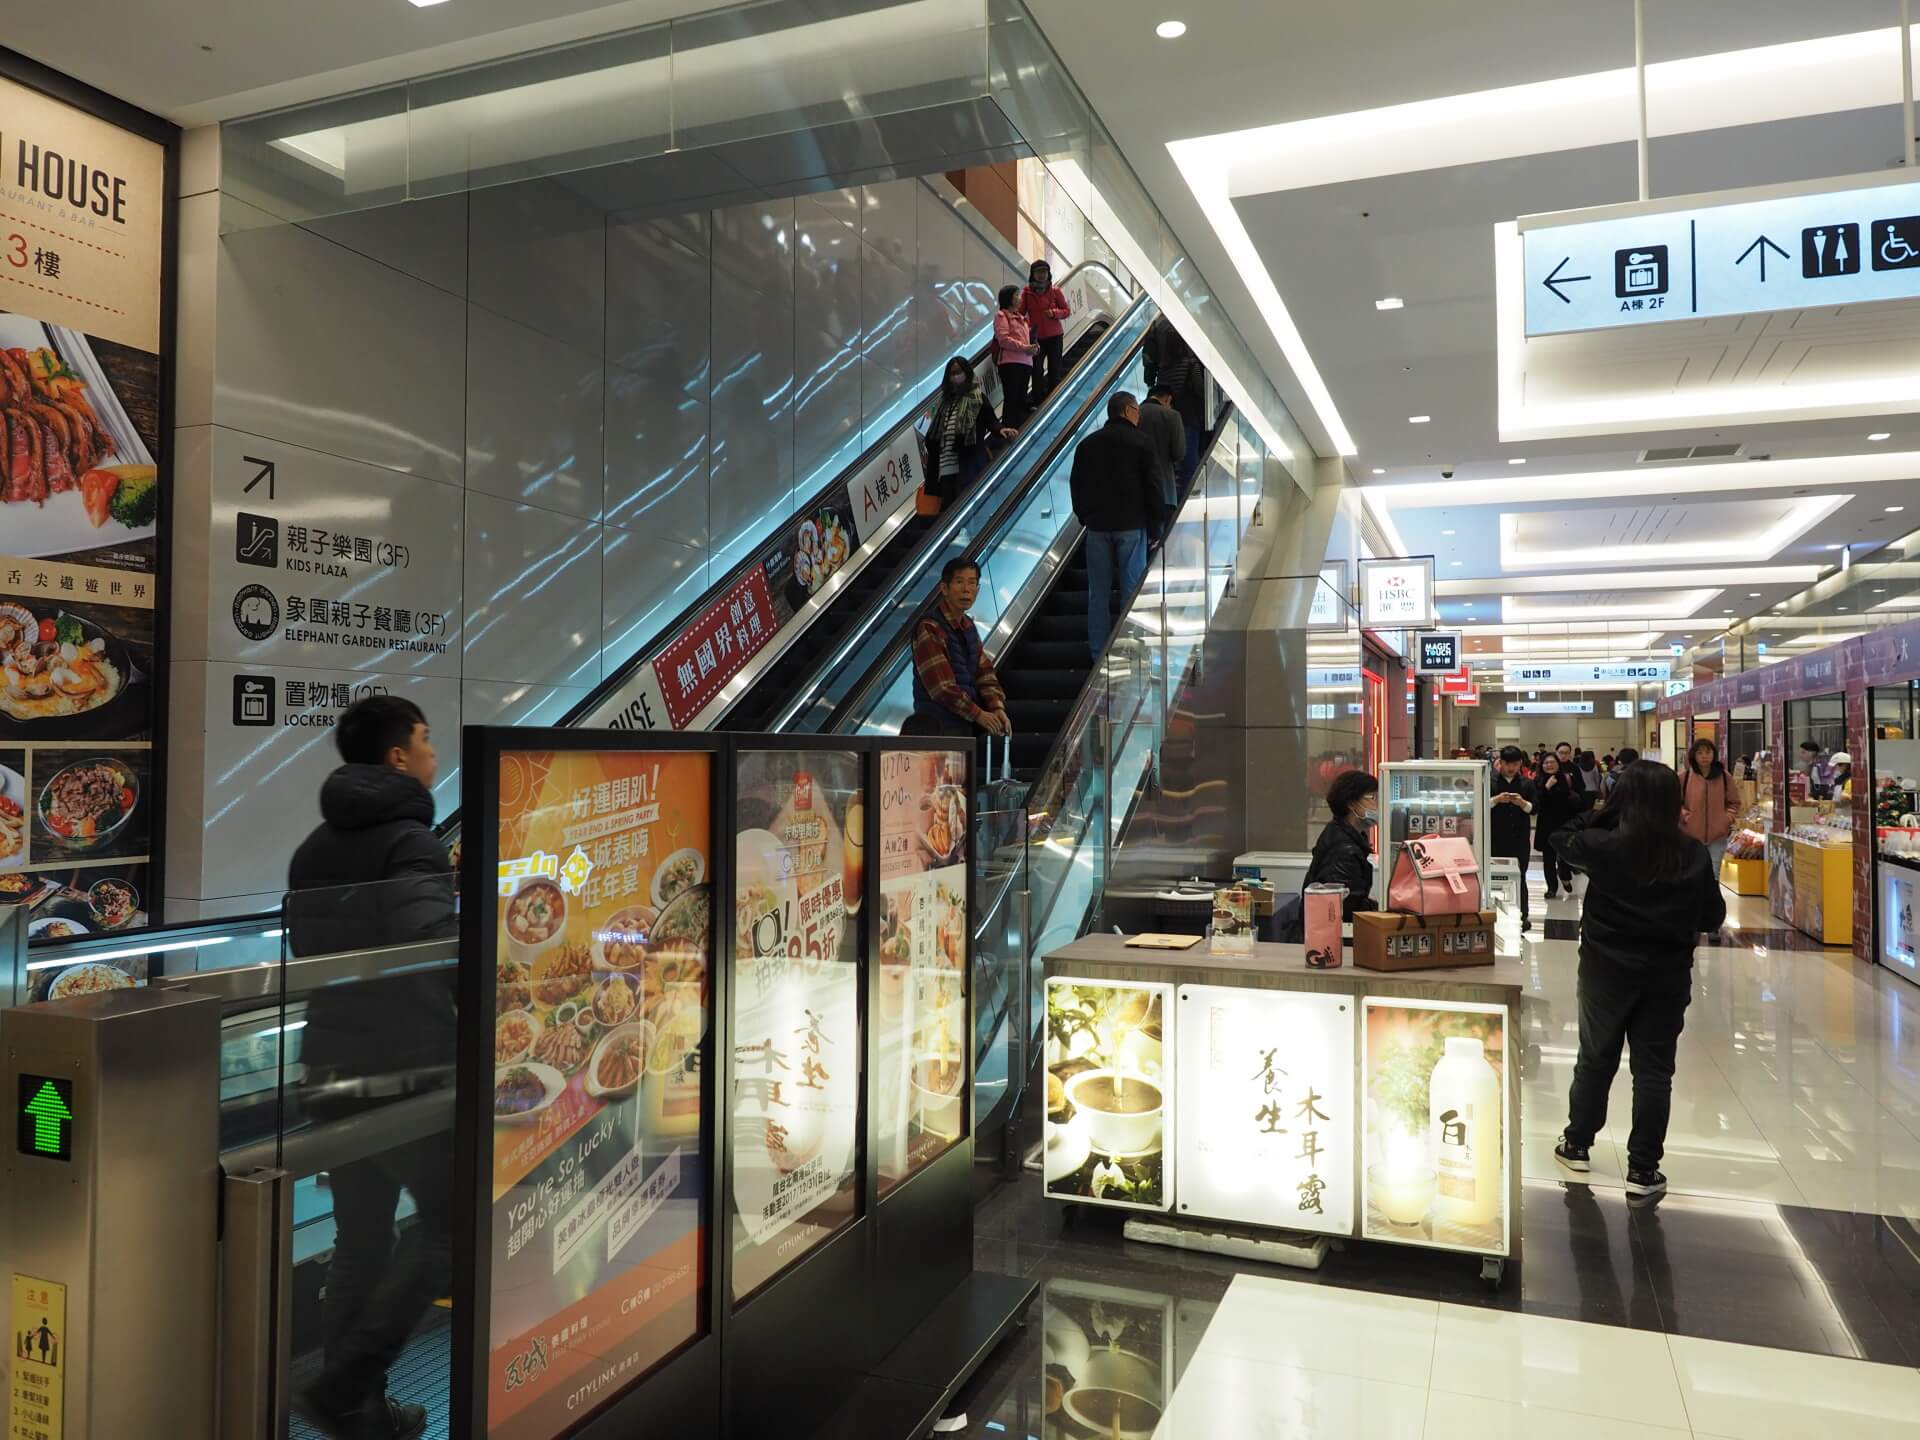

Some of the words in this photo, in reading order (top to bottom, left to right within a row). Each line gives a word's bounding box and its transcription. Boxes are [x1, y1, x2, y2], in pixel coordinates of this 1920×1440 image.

[18, 139, 127, 225] HOUSE
[71, 215, 96, 228] BAR
[7, 233, 62, 280] 3樓
[1620, 299, 1645, 313] A棟
[1649, 296, 1666, 310] 2F
[863, 452, 915, 523] A棟3樓
[287, 525, 410, 569] 親子樂園(3F)
[286, 558, 311, 574] KIDS
[314, 563, 349, 578] PLAZA
[730, 589, 756, 626] 創意
[1378, 588, 1413, 601] HSBC
[286, 596, 447, 637] 象園親子餐廳(3F)
[736, 611, 764, 652] 料理
[285, 628, 340, 646] ELEPHANT
[342, 633, 386, 650] GARDEN
[388, 637, 448, 655] RESTAURANT
[1425, 643, 1451, 651] MAGIC
[1425, 649, 1451, 657] TOUCH
[677, 622, 733, 699] 無國界
[284, 714, 335, 728] LOCKERS
[611, 814, 634, 830] SPRING
[1251, 1047, 1289, 1134] 養生
[558, 1156, 574, 1181] So
[1293, 1085, 1331, 1216] 木耳露
[566, 1364, 617, 1411] CITYLINK
